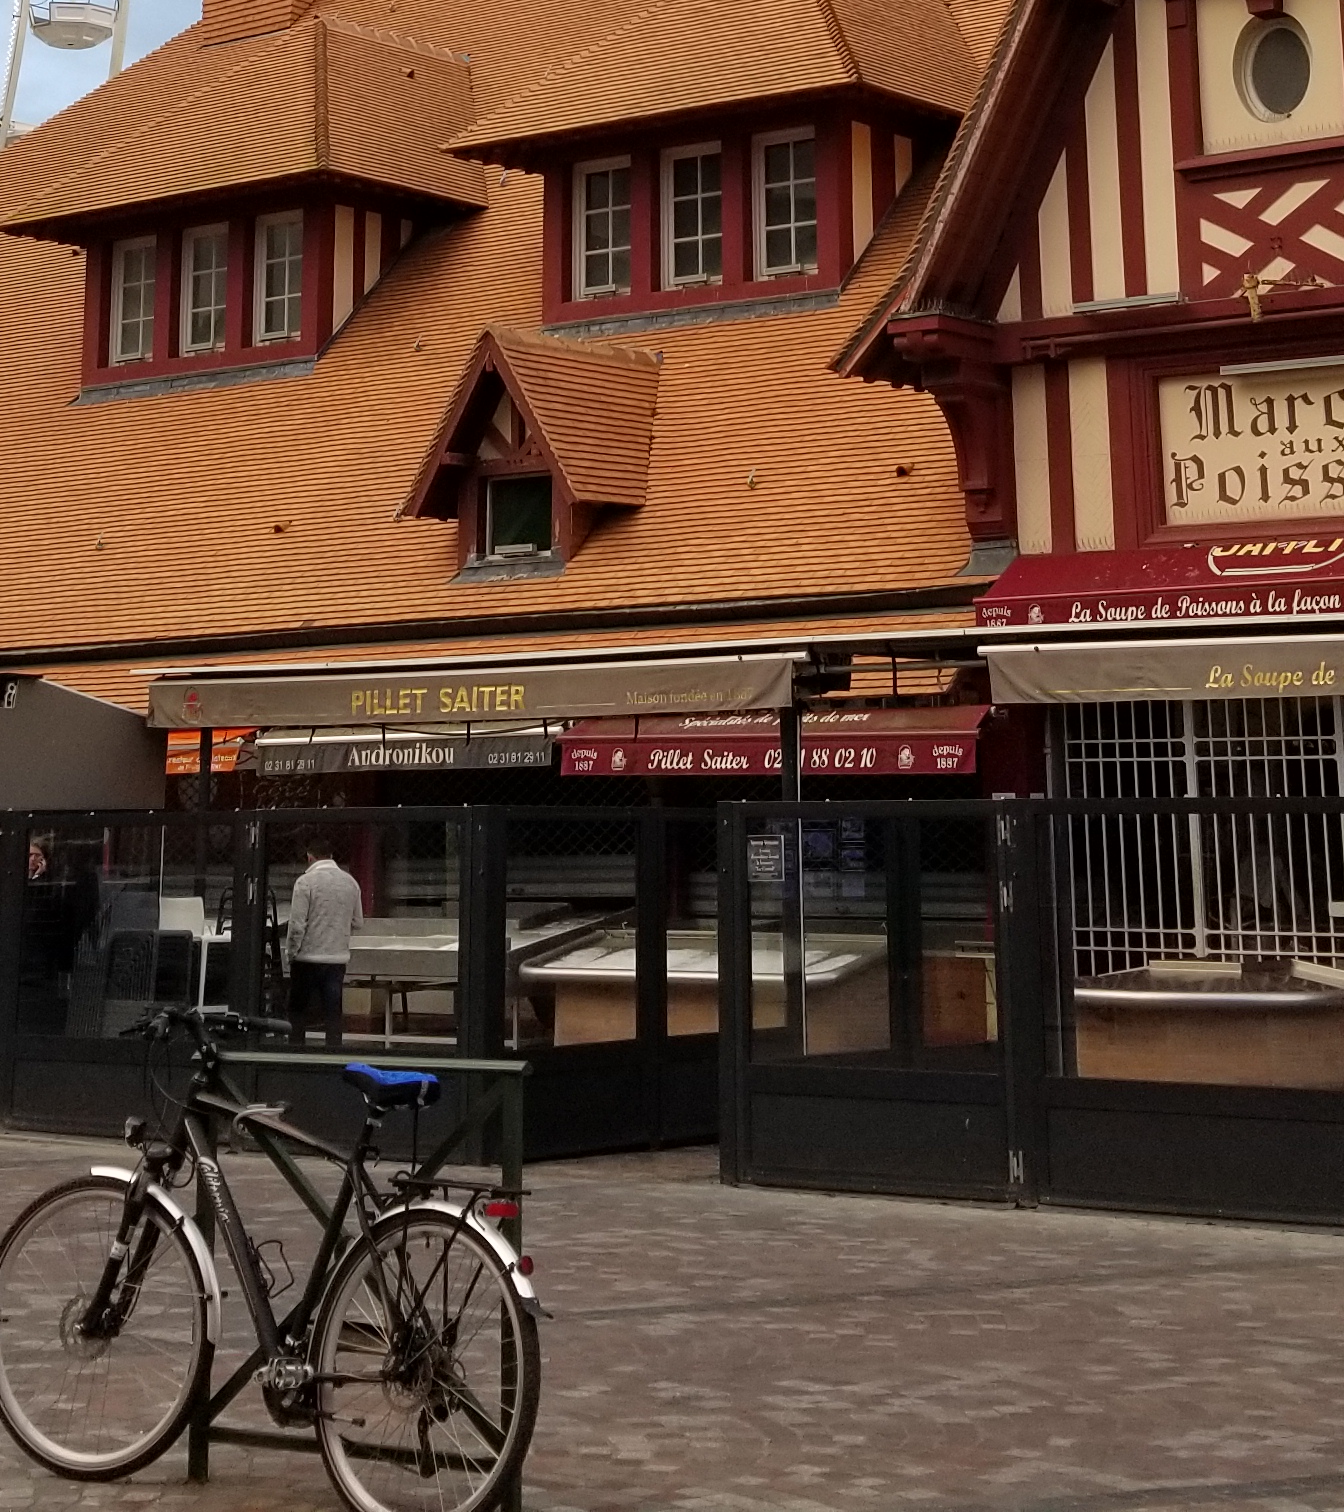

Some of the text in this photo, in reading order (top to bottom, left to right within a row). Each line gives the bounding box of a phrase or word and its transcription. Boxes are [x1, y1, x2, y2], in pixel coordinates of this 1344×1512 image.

[982, 604, 1012, 619] depuis
[1069, 601, 1092, 623] La
[1096, 600, 1146, 622] Soupe
[1151, 597, 1171, 619] de
[1176, 595, 1244, 617] Poissons
[1249, 592, 1262, 614] à
[1267, 590, 1287, 613] la
[1292, 588, 1341, 615] façon
[1205, 665, 1235, 689] La
[1239, 663, 1304, 693] Soupe
[1311, 661, 1336, 686] de
[351, 684, 526, 716] PILLET SAITER
[626, 691, 668, 706] Maison
[669, 688, 708, 704] fondée
[709, 691, 723, 703] en
[753, 711, 773, 725] de
[307, 759, 315, 769] 11
[347, 742, 455, 767] Andronikou
[488, 753, 498, 764] 02
[499, 752, 509, 764] 31
[535, 751, 545, 763] 11
[571, 747, 598, 760] depuis
[932, 744, 964, 756] depuis
[574, 760, 594, 771] 1887
[647, 748, 694, 770] Pillet
[700, 748, 750, 770] Saiter
[763, 748, 782, 768] 02
[810, 747, 831, 768] 88
[834, 747, 856, 768] 02
[859, 747, 877, 768] 10
[936, 757, 959, 769] 1887
